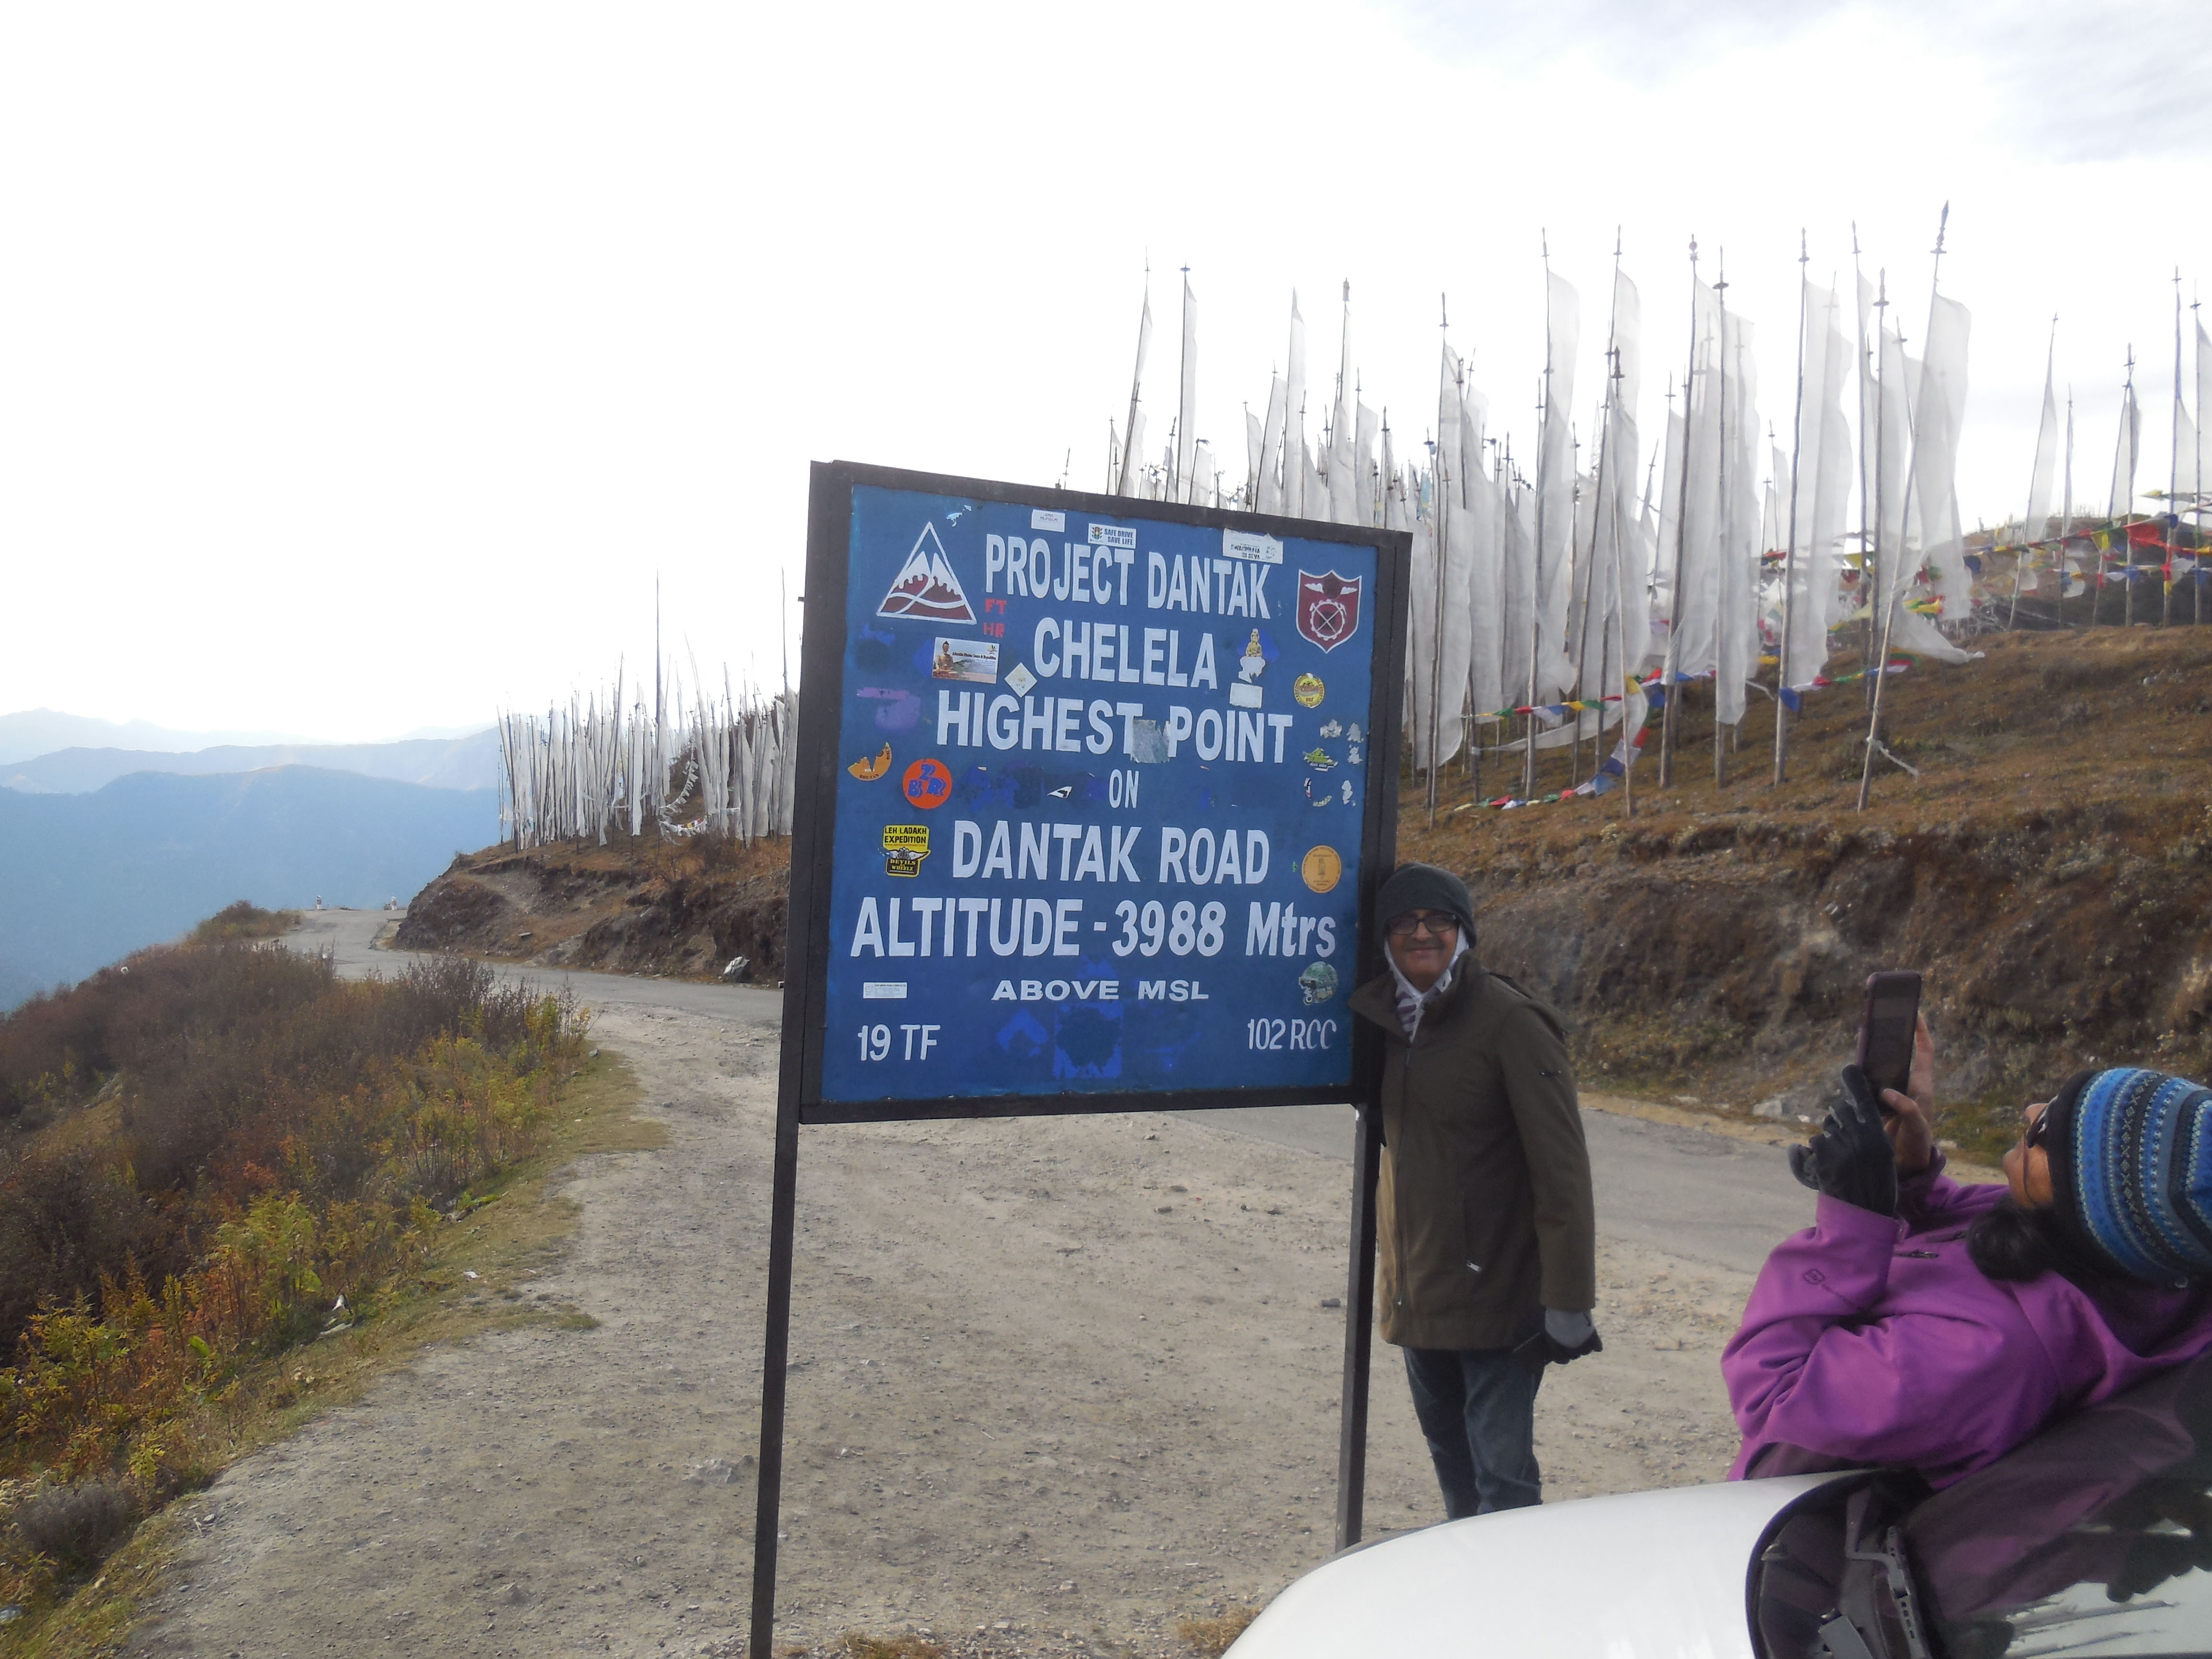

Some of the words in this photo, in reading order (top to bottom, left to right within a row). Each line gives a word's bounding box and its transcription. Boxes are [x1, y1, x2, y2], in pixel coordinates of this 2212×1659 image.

[986, 534, 1134, 605] PROJECT
[1148, 552, 1271, 619] DANTAK
[1034, 617, 1218, 689] CHELELA
[937, 690, 1143, 755] HIGHEST
[1167, 706, 1293, 763] POINT
[1109, 769, 1139, 808] ON
[953, 820, 1142, 882] DANTAK
[1159, 827, 1269, 885] ROAD
[851, 897, 1083, 957] ALTITUDE
[1112, 900, 1226, 957] 3988
[1246, 902, 1335, 957] Mtrs
[991, 980, 1118, 1000] ABOVE
[1138, 980, 1208, 1001] MSL
[857, 1024, 891, 1061] 19
[900, 1024, 941, 1060] TF
[1248, 1018, 1286, 1050] 102
[1290, 1019, 1336, 1050] RCC
